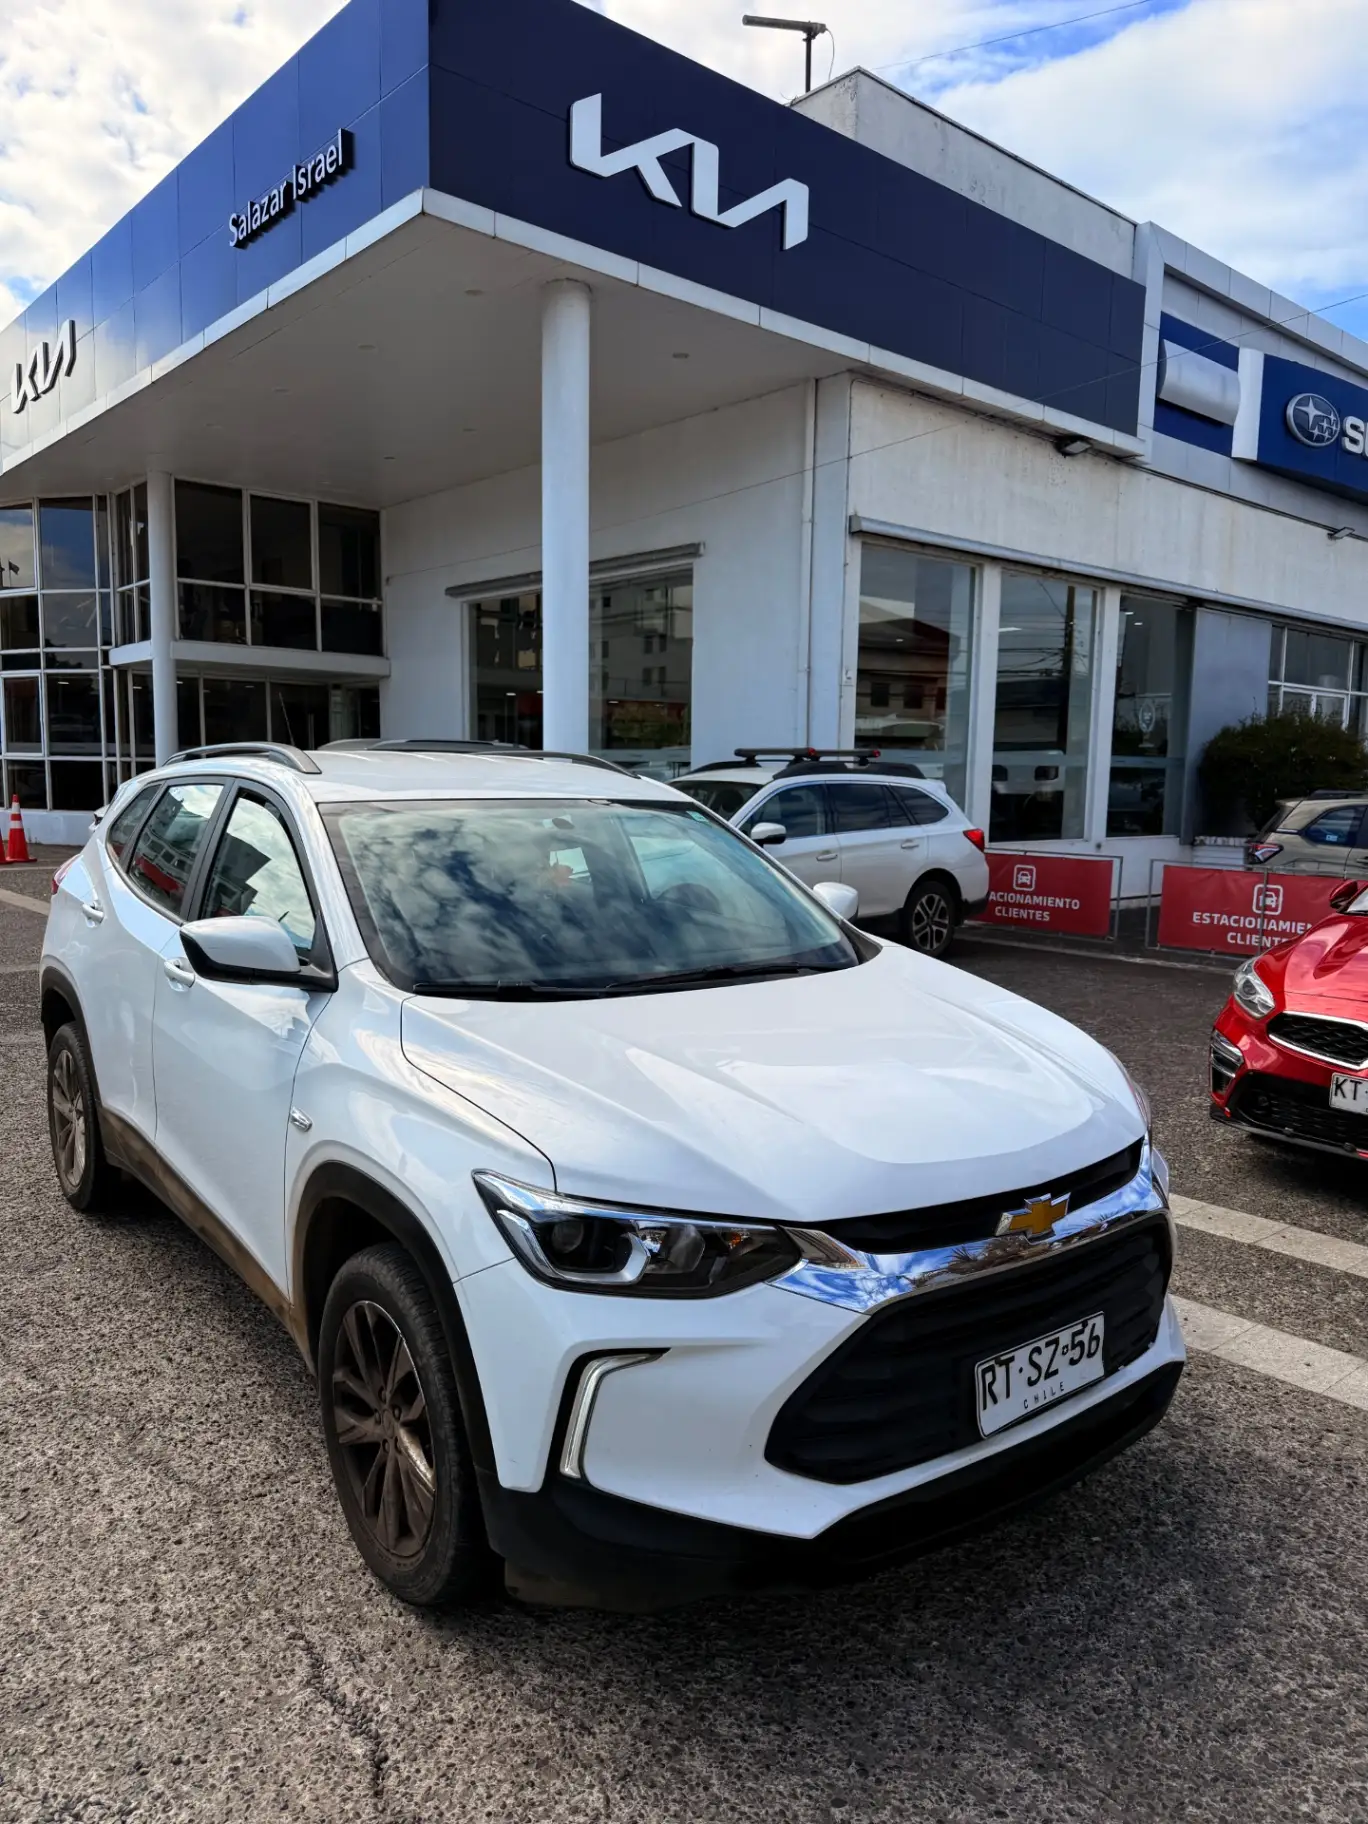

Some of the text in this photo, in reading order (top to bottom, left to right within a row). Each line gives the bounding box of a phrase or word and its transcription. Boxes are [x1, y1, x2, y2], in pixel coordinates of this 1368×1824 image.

[229, 127, 344, 247] Salazar Israel
[1341, 415, 1368, 457] S
[989, 891, 1080, 910] ACIONAMIENTO
[995, 906, 1050, 921] CLIENTES
[1226, 932, 1289, 948] CLIENT
[1023, 1381, 1065, 1409] CHILE
